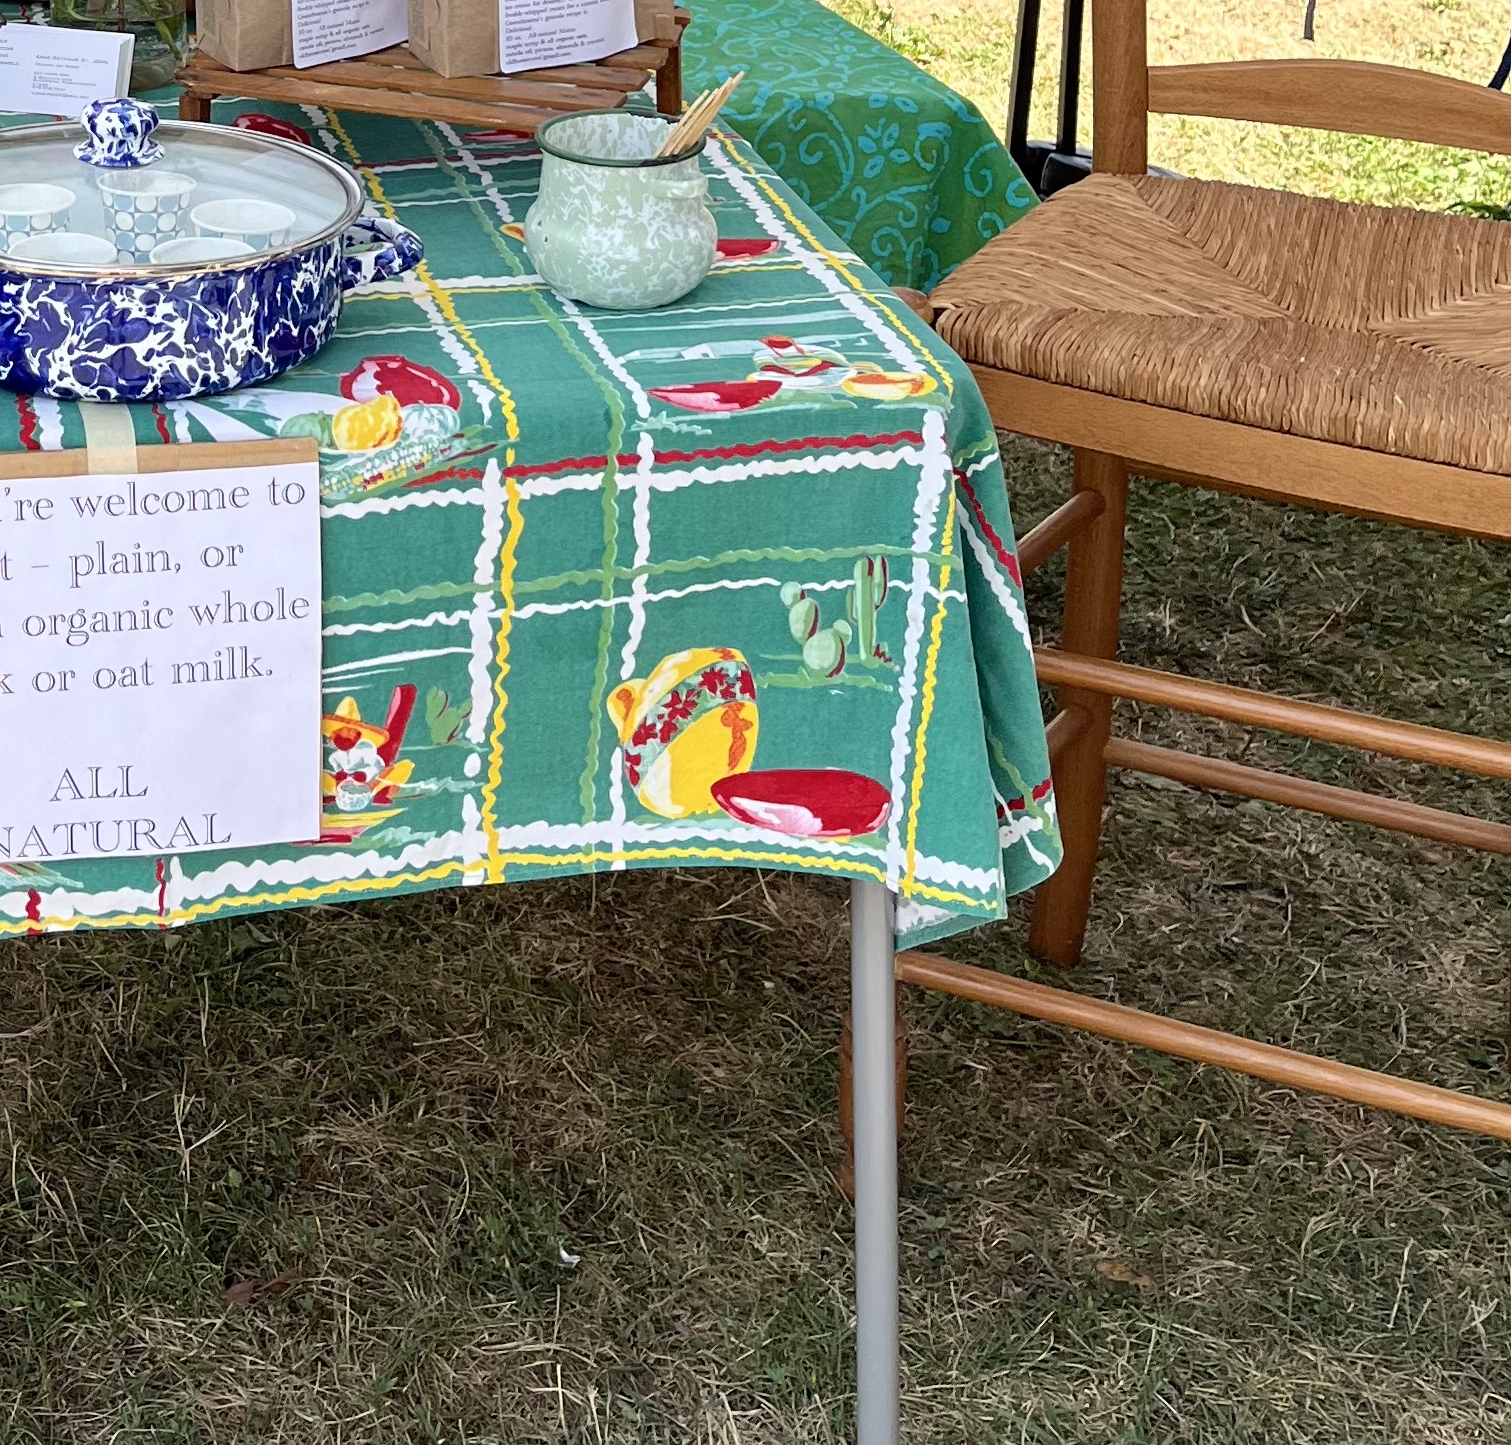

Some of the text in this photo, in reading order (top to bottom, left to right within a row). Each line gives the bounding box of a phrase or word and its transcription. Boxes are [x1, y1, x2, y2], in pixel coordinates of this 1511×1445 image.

[70, 481, 251, 518] welcome
[267, 476, 307, 507] to
[69, 540, 182, 589] plain,
[200, 544, 244, 568] or
[21, 600, 174, 646] organic
[190, 587, 310, 626] whole
[31, 669, 76, 694] or
[92, 658, 155, 690] oat
[171, 646, 274, 685] milk.
[49, 765, 149, 802] ALL
